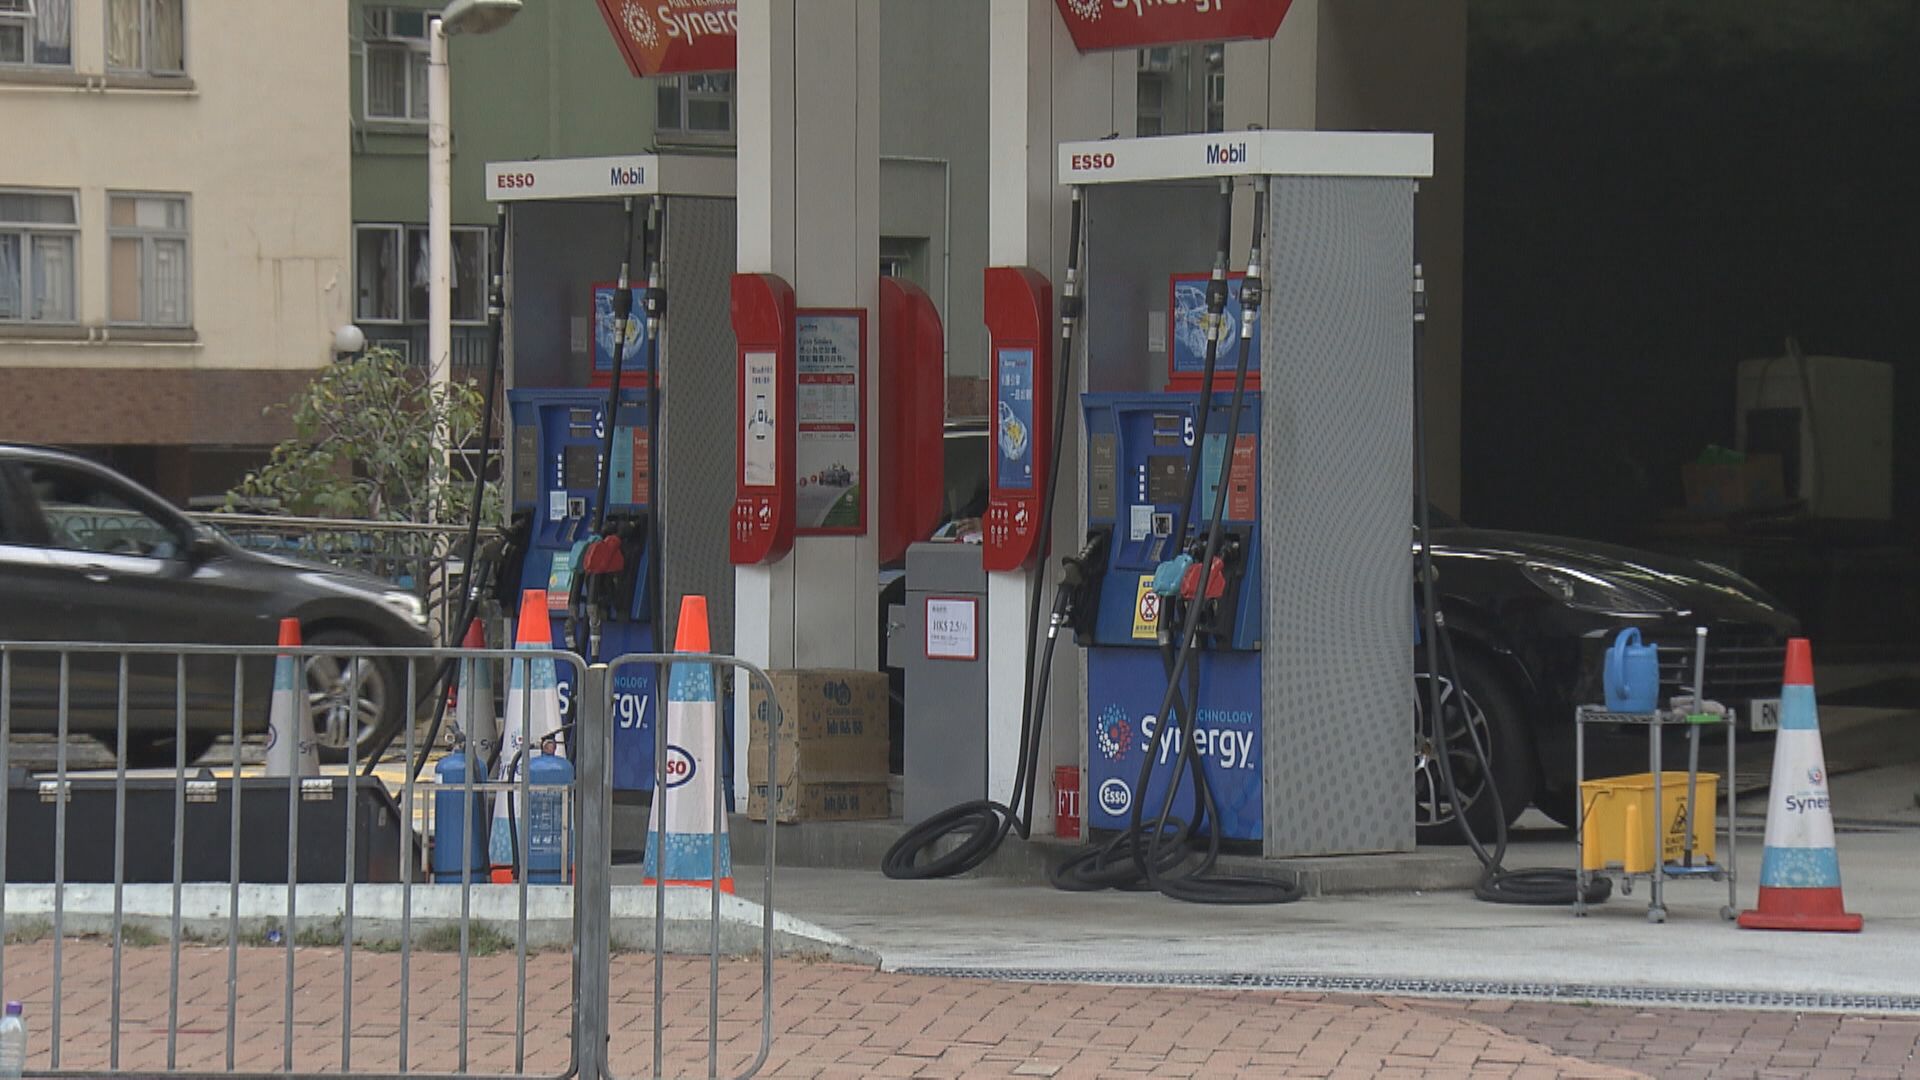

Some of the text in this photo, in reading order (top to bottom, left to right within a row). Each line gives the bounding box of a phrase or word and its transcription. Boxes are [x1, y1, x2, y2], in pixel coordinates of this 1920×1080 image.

[1072, 153, 1115, 170] ESSO
[1207, 143, 1246, 164] Mobil
[497, 173, 535, 188] ESSO
[610, 167, 645, 186] Mobil
[1184, 417, 1195, 447] 5
[1198, 707, 1253, 724] CHNOLOGY
[1104, 788, 1126, 804] Esso
[1786, 795, 1832, 815] Syner
